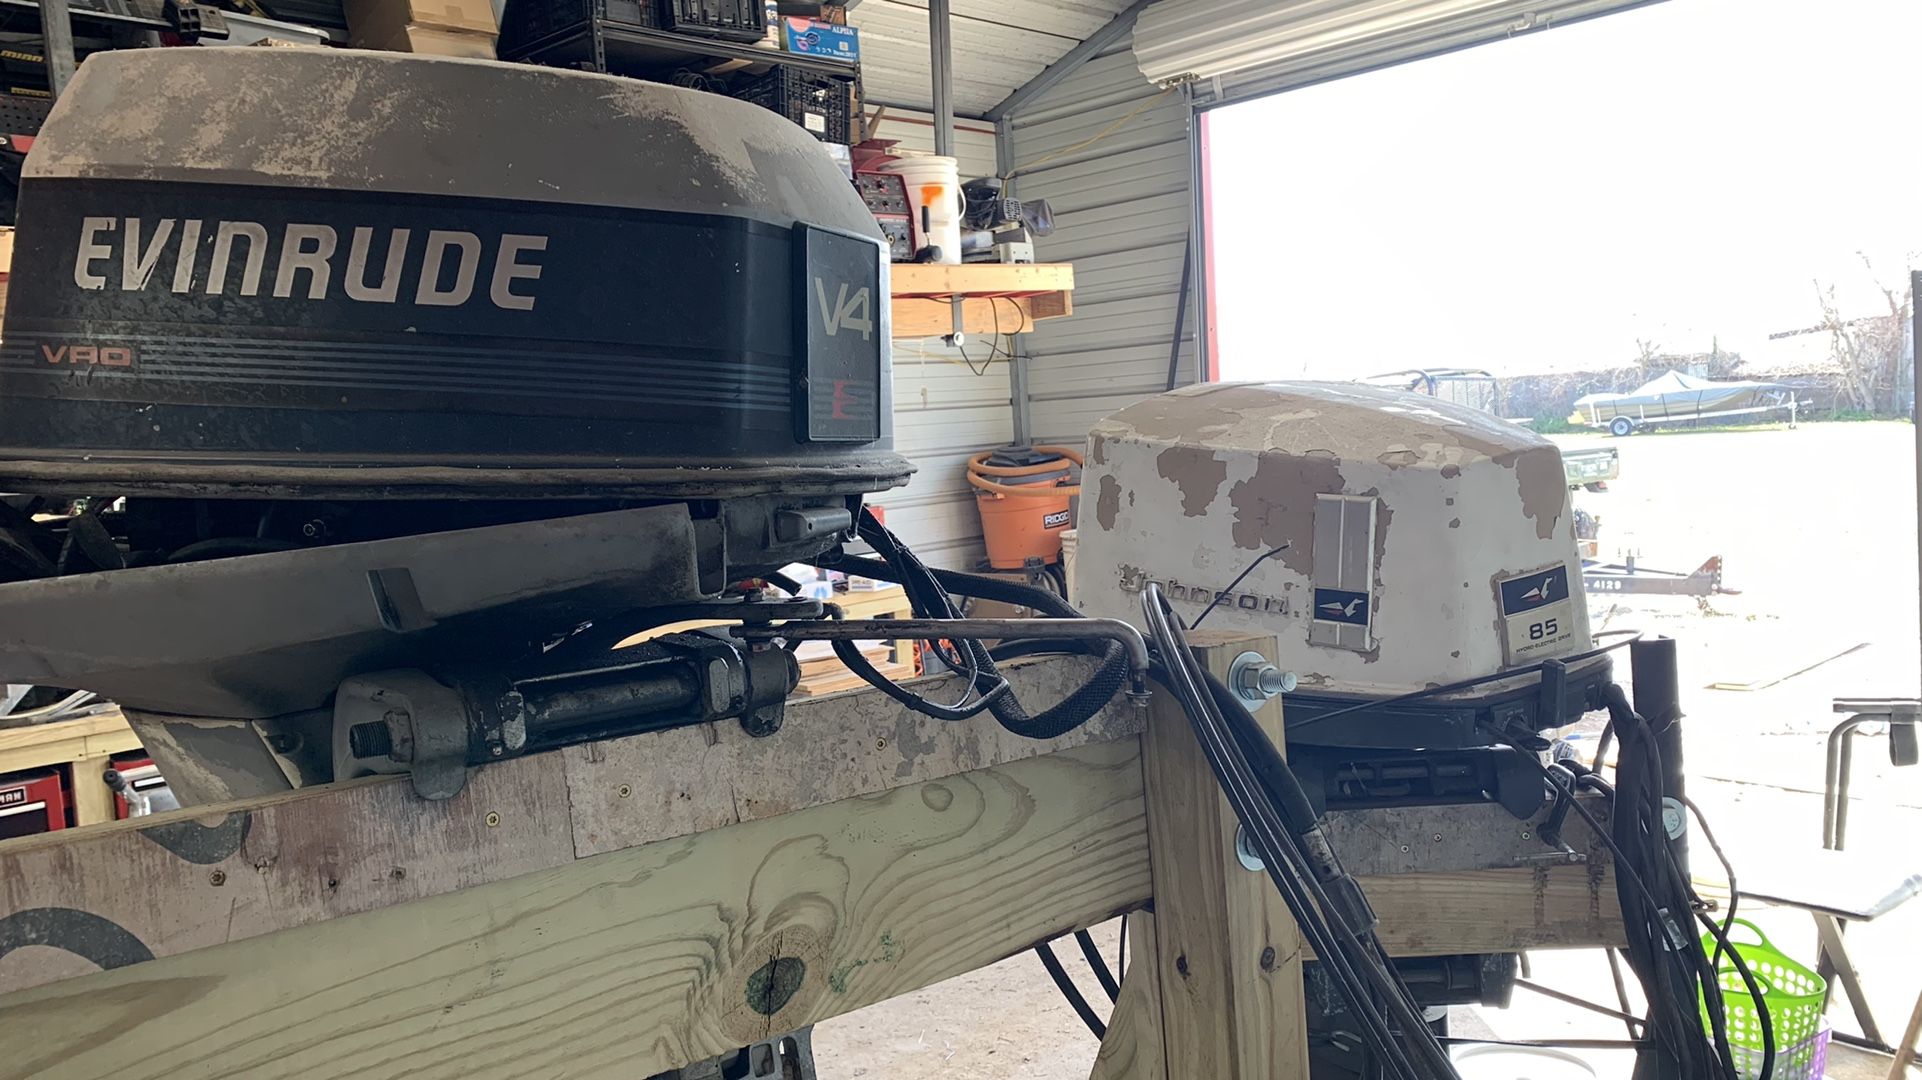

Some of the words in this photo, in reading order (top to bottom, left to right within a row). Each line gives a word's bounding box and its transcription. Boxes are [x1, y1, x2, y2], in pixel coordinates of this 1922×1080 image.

[74, 217, 548, 310] EVINRUDE
[814, 277, 873, 341] V4
[1529, 618, 1558, 640] 85
